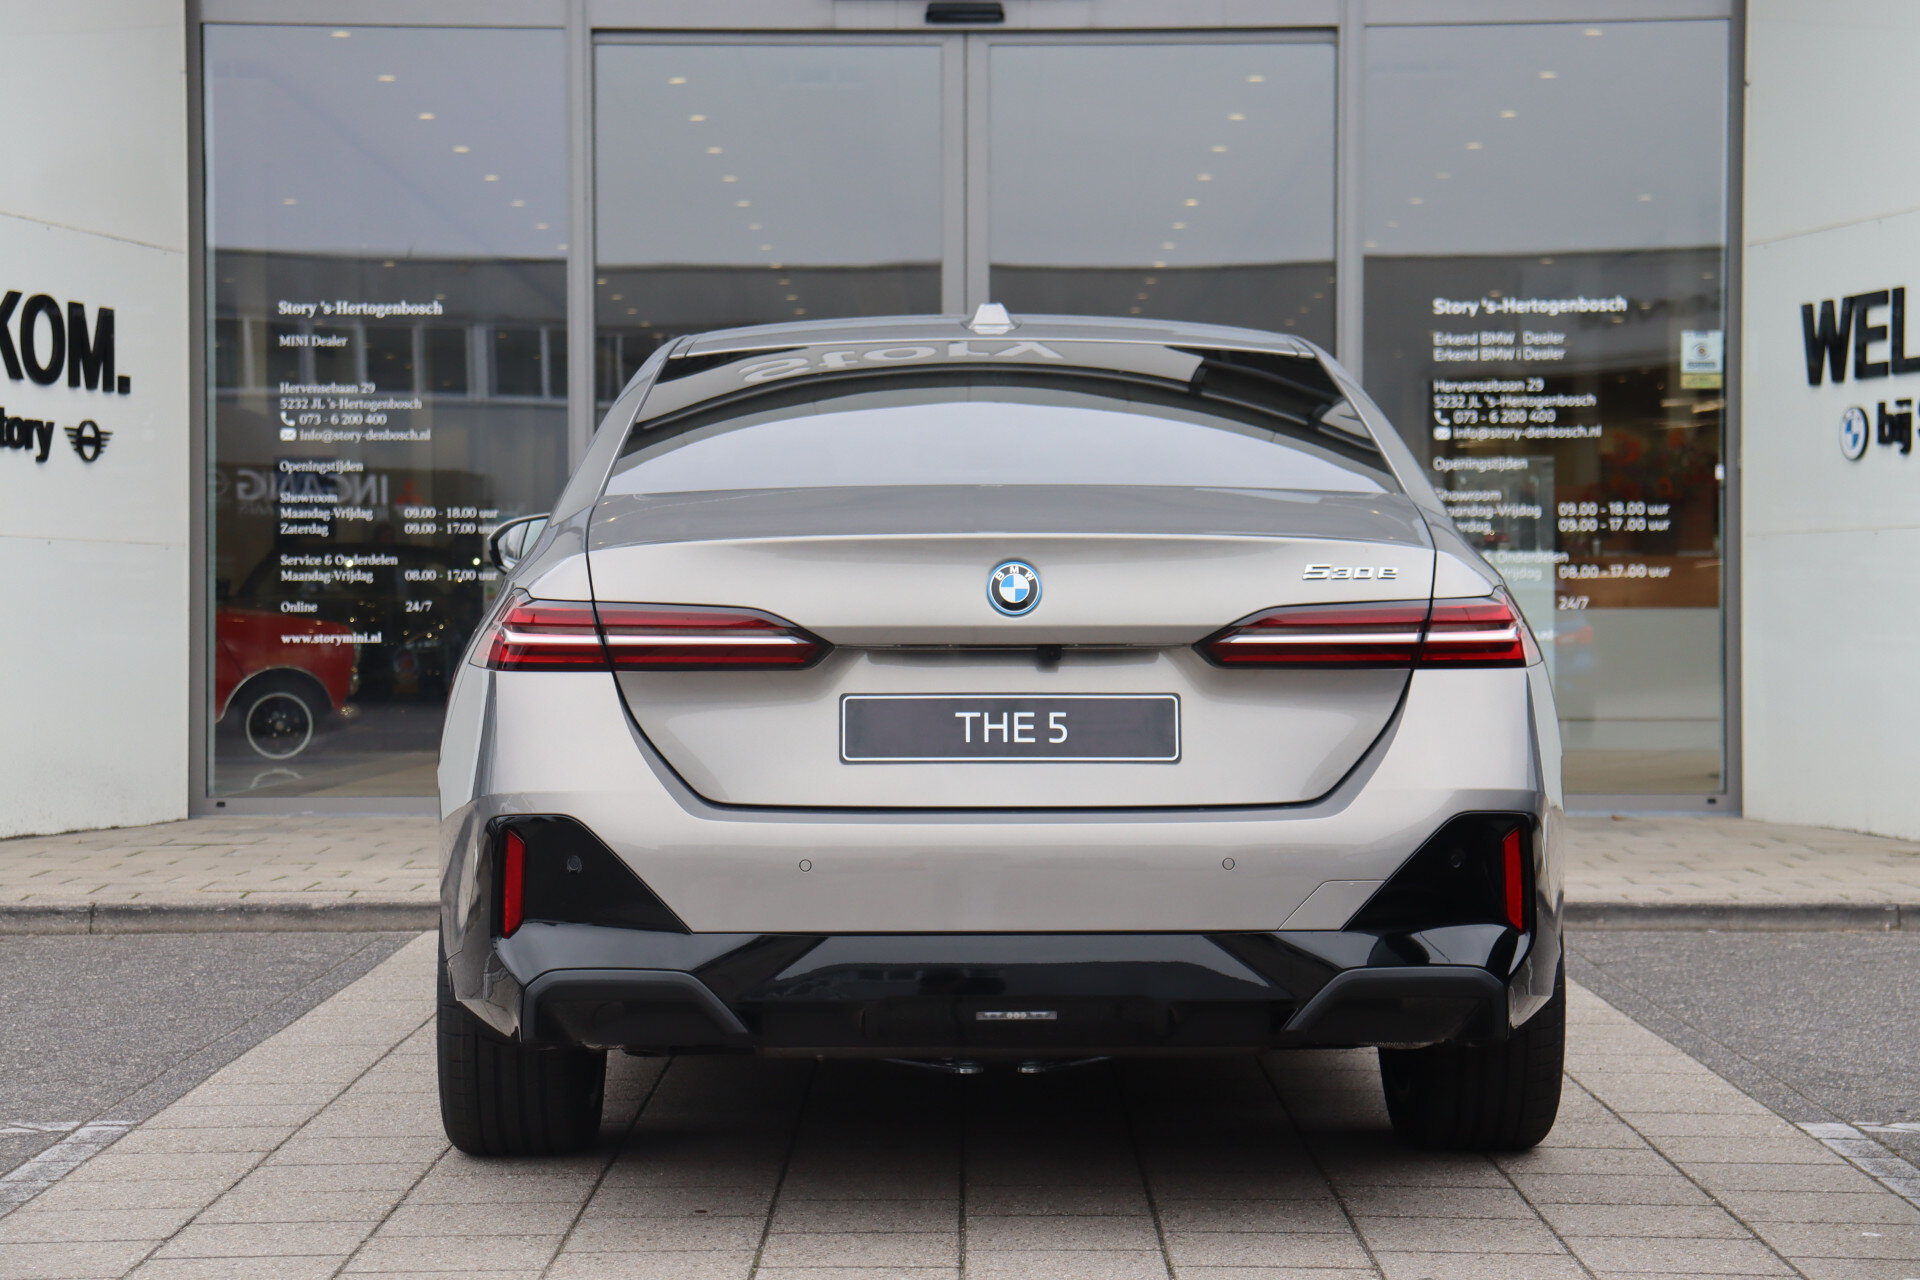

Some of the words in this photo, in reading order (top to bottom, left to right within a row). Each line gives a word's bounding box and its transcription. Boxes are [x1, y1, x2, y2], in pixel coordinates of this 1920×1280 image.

[278, 300, 317, 318] Story
[320, 300, 443, 318] 's-Hertogenbosch
[1432, 298, 1479, 317] Story
[1481, 296, 1628, 316] 's-Hertogenbosch
[279, 335, 309, 348] MINI
[311, 334, 348, 348] Dealer
[1433, 332, 1479, 346] Erkend
[1480, 331, 1516, 346] BMW
[1522, 330, 1567, 345] Dealer
[1801, 286, 1920, 387] WEL
[1433, 347, 1479, 362] Erkend
[1480, 347, 1515, 361] BMW
[1522, 346, 1567, 361] Dealer
[279, 382, 359, 394] Hervensebaan
[360, 382, 376, 394] 29
[1433, 379, 1526, 393] Hervensebaan
[1526, 377, 1545, 392] 29
[280, 398, 309, 410] 5232
[310, 398, 325, 410] JL
[327, 397, 422, 412] 's-Hertogenbosch
[1433, 395, 1466, 409] 5232
[1467, 395, 1482, 410] JL
[1484, 394, 1597, 409] 's-Hertogenbosch
[299, 413, 321, 425] 073
[330, 413, 340, 425] 6
[341, 413, 364, 425] 200
[365, 413, 387, 425] 400
[1453, 411, 1479, 424] 073
[1488, 410, 1499, 424] 6
[1500, 410, 1528, 424] 200
[1529, 409, 1556, 423] 400
[1453, 425, 1602, 441] info@story-denbosch.nl
[1877, 398, 1912, 456] bij
[300, 428, 431, 443] info@story-denbosch.nl
[279, 460, 364, 474] Openingstijden
[1433, 456, 1528, 473] Openingstijden
[280, 492, 338, 504] Showroom
[280, 507, 374, 521] Maandag-Vrijdag
[404, 507, 436, 519] 09.00
[446, 506, 477, 519] 18.00
[478, 509, 499, 519] uur
[1558, 502, 1599, 516] 09.00
[1608, 501, 1645, 516] 18.00
[1647, 504, 1671, 516] uur
[280, 522, 329, 537] Zaterdag
[404, 522, 437, 534] 09.00
[446, 522, 477, 534] 17.00
[1558, 518, 1599, 532] 09.00
[1608, 517, 1646, 531] 17.00
[1647, 520, 1671, 531] uur
[280, 554, 322, 566] Service
[323, 555, 332, 566] &
[1496, 551, 1570, 564] Onderdelen
[280, 570, 374, 584] Maandag-Vrijdag
[404, 569, 437, 581] 08.00
[447, 569, 477, 581] 17.00
[478, 571, 498, 581] uur
[1558, 565, 1599, 579] 08.00
[1608, 564, 1647, 579] 17.00
[1648, 567, 1671, 579] uur
[280, 600, 318, 613] Online
[405, 600, 432, 613] 24/7
[1558, 596, 1589, 610] 24/7
[281, 632, 382, 646] www.storymini.nl
[954, 711, 1036, 743] THE
[1048, 711, 1068, 743] 5
